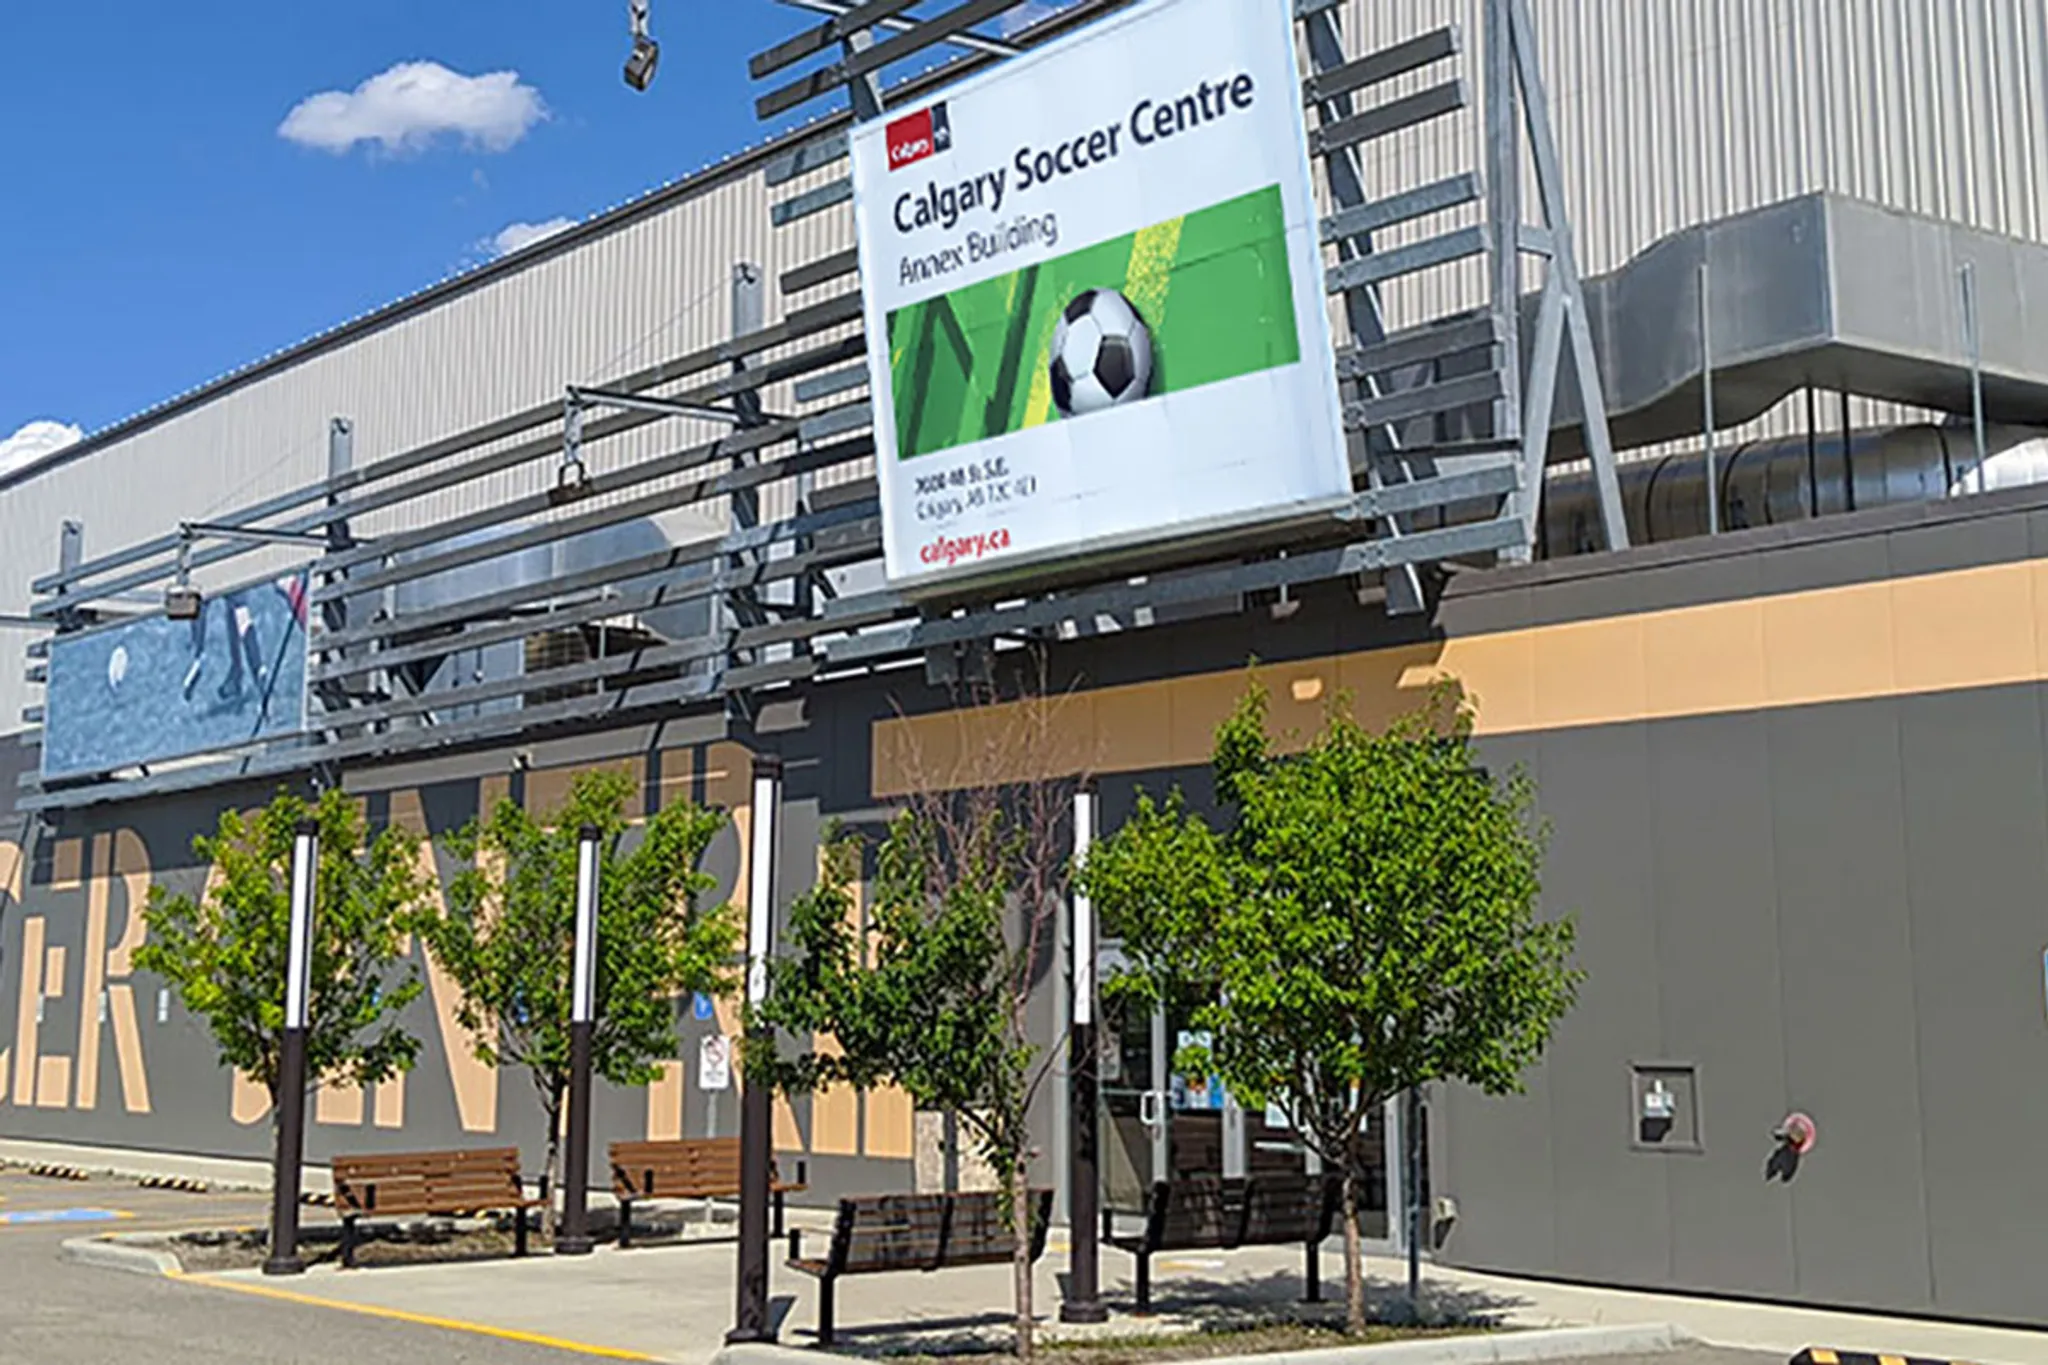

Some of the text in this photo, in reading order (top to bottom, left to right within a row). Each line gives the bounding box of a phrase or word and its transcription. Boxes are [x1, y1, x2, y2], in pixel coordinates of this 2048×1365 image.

[894, 72, 1255, 233] Calgary Soccer Centre
[899, 213, 1059, 286] Annex Building
[920, 528, 1011, 566] calgary.ca
